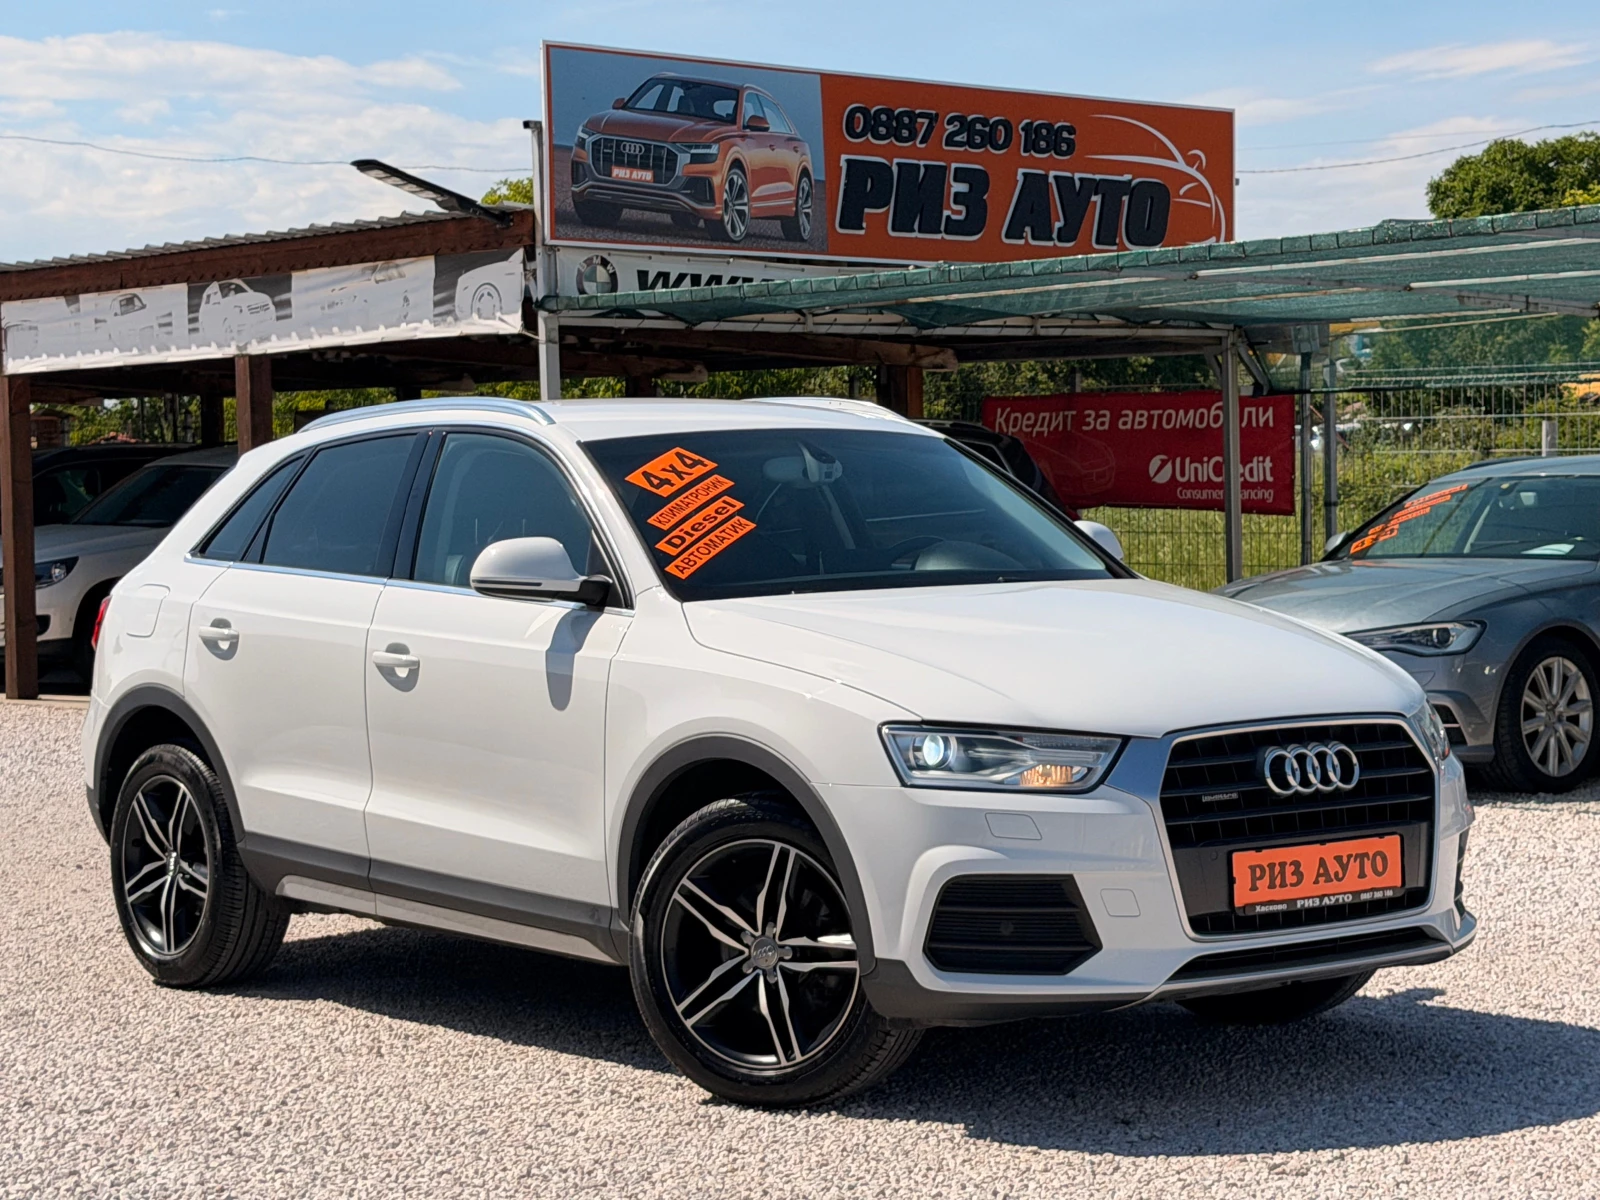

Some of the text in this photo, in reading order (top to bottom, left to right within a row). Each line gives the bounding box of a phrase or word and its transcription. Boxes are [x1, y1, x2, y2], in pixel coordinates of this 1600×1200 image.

[842, 103, 1077, 159] 0887 260 186
[613, 168, 630, 179] РИЗ
[836, 154, 1172, 251] РИЗ АУТО
[995, 401, 1274, 437] Кредит за автомобли
[652, 477, 729, 527] КЛИМАТРОНИК
[664, 499, 737, 550] Diesel
[673, 518, 751, 576] АВТОМАТИК
[1247, 849, 1389, 892] РИЗ АУТО
[1296, 897, 1320, 909] РИЗ
[1321, 893, 1353, 906] АУТО
